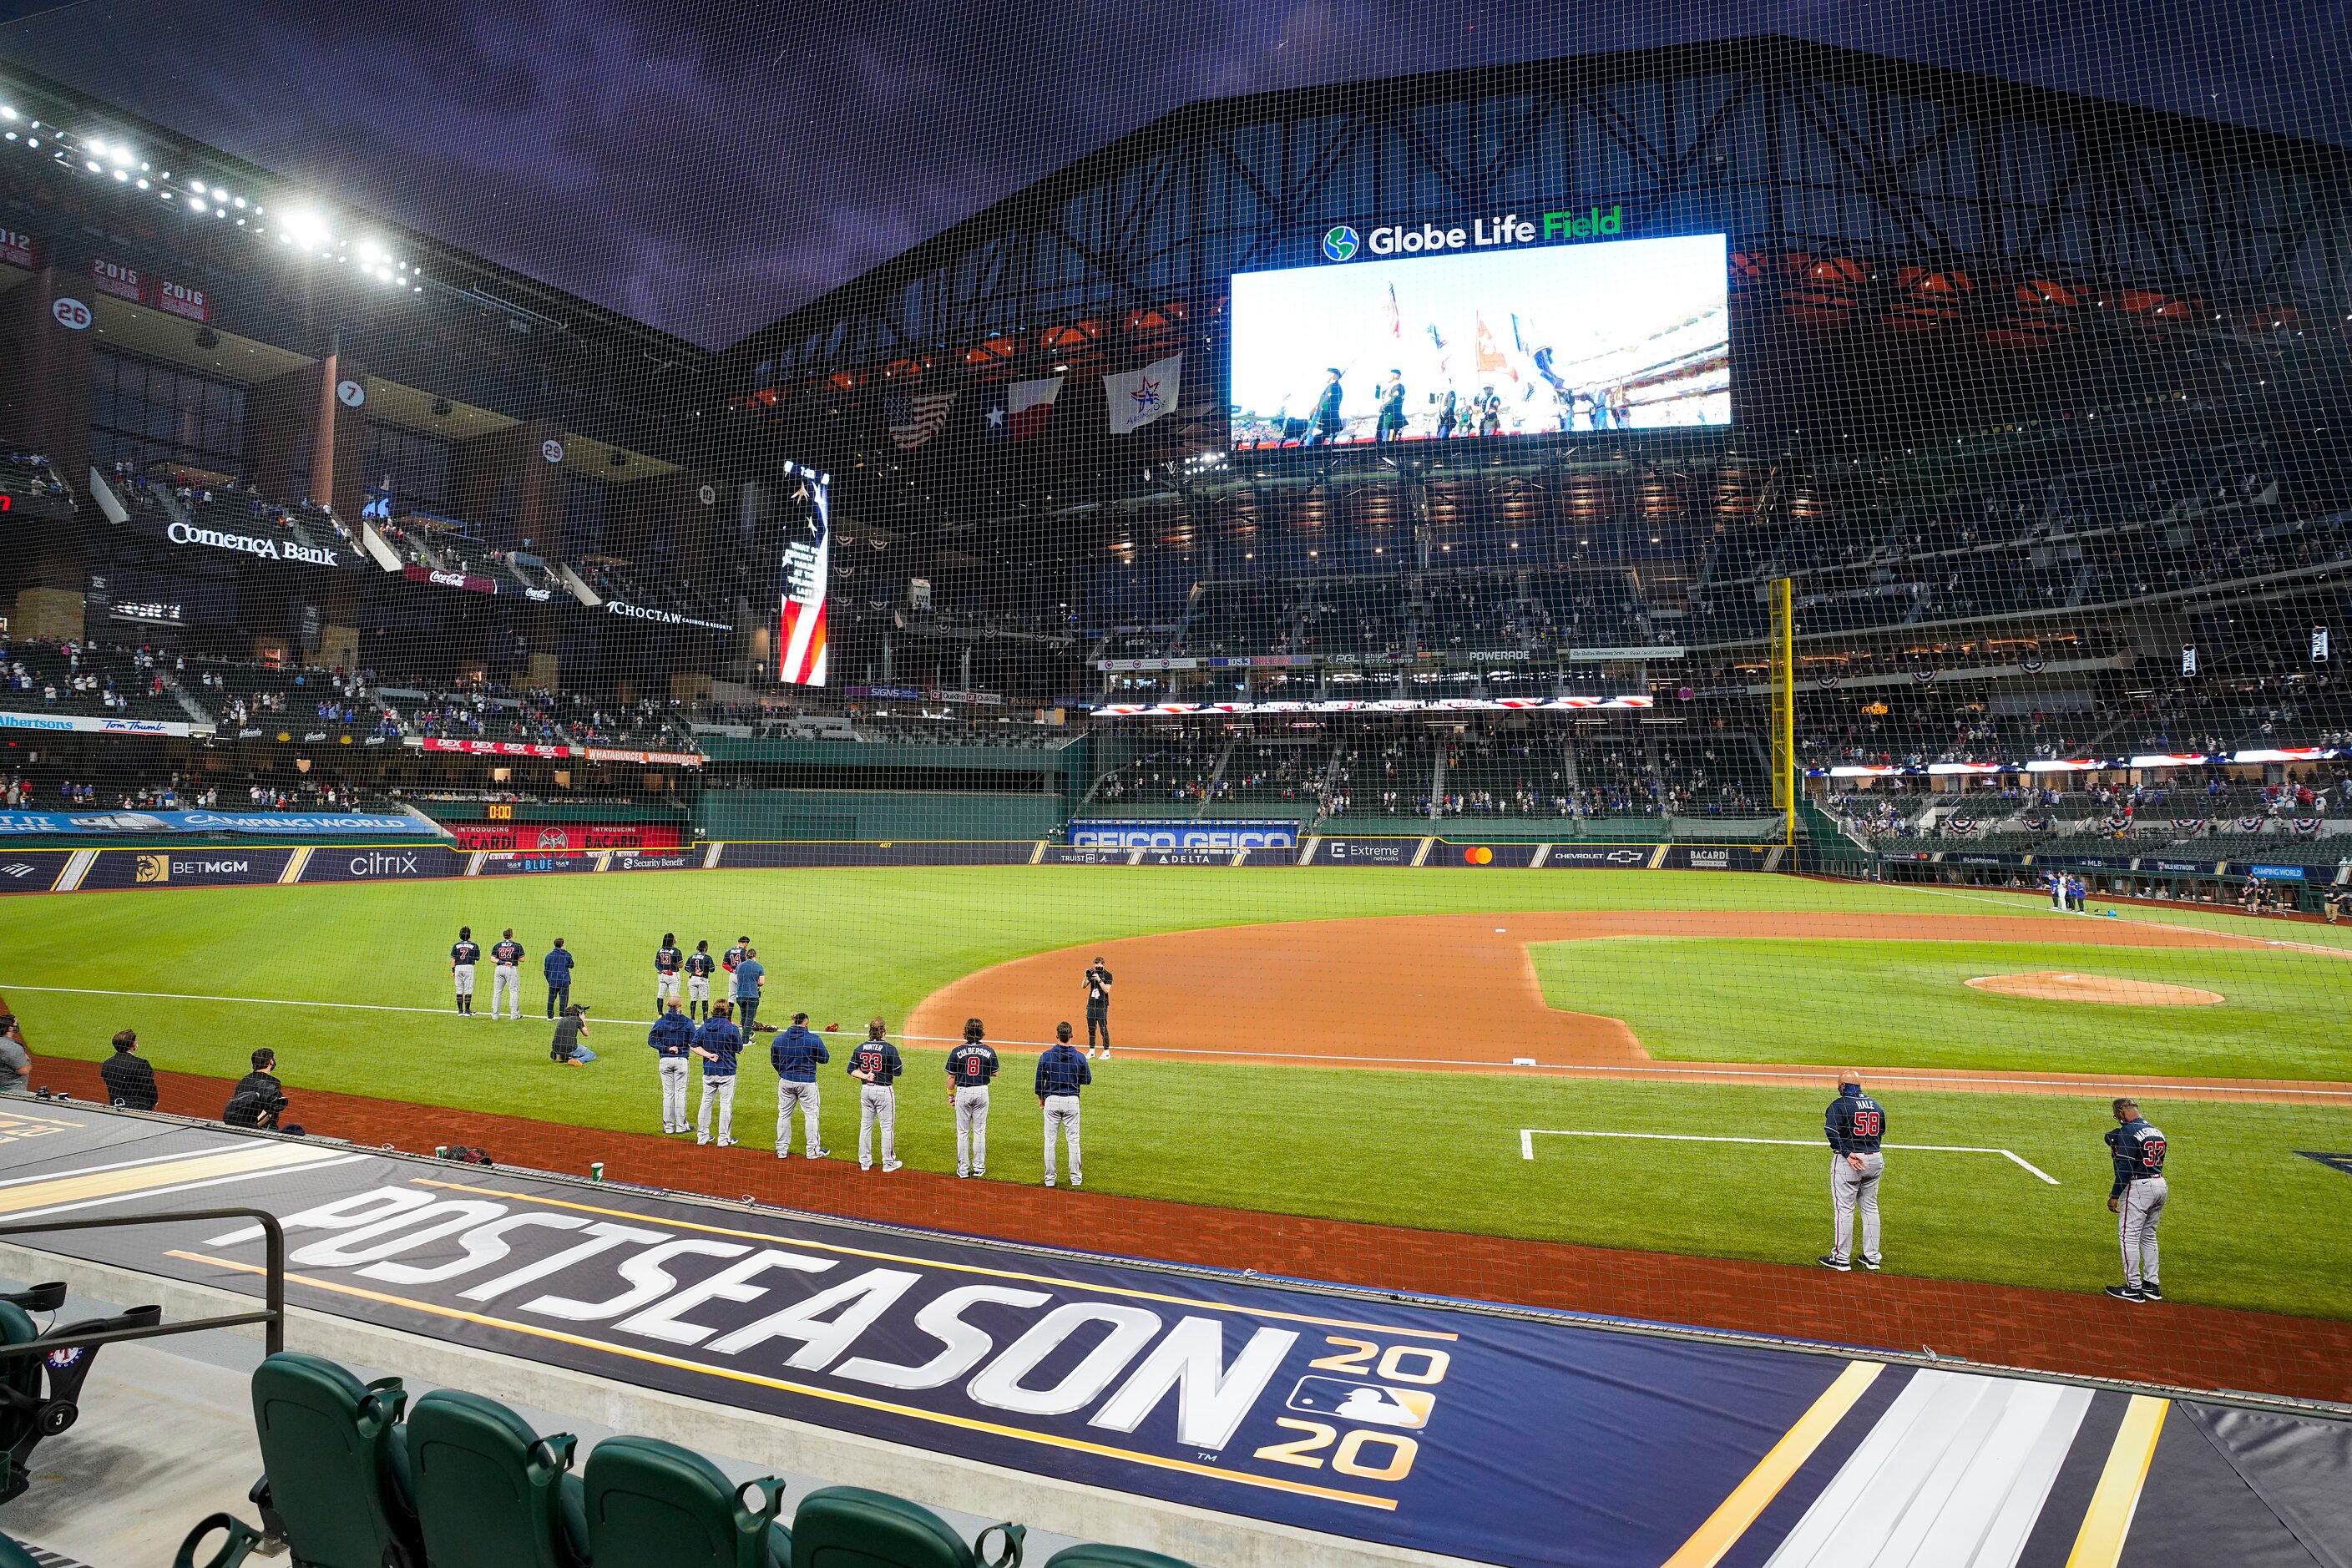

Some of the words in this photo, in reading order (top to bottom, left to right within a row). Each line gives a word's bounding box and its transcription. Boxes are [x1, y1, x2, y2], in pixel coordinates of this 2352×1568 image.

[1368, 223, 1466, 255] Globe
[1474, 215, 1535, 246] Life
[1543, 205, 1621, 240] Field
[94, 260, 137, 285] 2015
[163, 281, 204, 306] 2016
[57, 301, 88, 325] 26
[346, 387, 357, 399] 7
[544, 443, 560, 459] 29
[282, 541, 338, 566] Bank
[430, 570, 466, 587] Coca-Cola
[615, 602, 681, 625] CHOCTAW
[2313, 632, 2323, 657] TRULY
[1228, 658, 1251, 666] 105.3
[1252, 656, 1269, 665] THE
[1272, 655, 1292, 665] FAN
[1336, 655, 1359, 663] PGL
[1469, 651, 1530, 660] POWERADE
[2183, 650, 2191, 670] TRULY
[871, 688, 900, 697] SIGNS
[943, 692, 966, 701] QuikTrip
[978, 695, 999, 703] QuikTrip
[0, 716, 73, 730] Albertsons
[102, 720, 126, 730] Tom
[125, 721, 165, 731] Thumb
[437, 739, 463, 747] DEX
[589, 749, 643, 761] WHATABURGER
[648, 752, 699, 764] WHATABURGER
[489, 806, 512, 819] 0:00
[184, 815, 315, 827] CAMPING
[311, 818, 407, 827] WORLD
[458, 831, 518, 850] ACARDÍ
[585, 831, 642, 848] BACARDÍ
[1074, 832, 1176, 854] GEICO
[1183, 832, 1291, 854] GEICO
[1351, 845, 1399, 855] Extreme
[1690, 848, 1728, 860] BACARDÍ
[351, 852, 417, 875] citrix
[525, 860, 553, 869] BLUE
[634, 858, 660, 867] Security
[1171, 855, 1210, 863] DELTA
[173, 861, 248, 874] BETMGM
[2253, 867, 2282, 876] CAMPING
[460, 948, 468, 959] 7
[498, 948, 514, 959] 27
[660, 953, 671, 964] 13
[730, 953, 741, 965] 14
[695, 959, 700, 970] 1
[863, 1044, 883, 1052] MINTER
[957, 1046, 992, 1059] CULBERSON
[860, 1053, 883, 1072] 33
[967, 1056, 980, 1076] 8
[1855, 1100, 1874, 1110] HALE
[1854, 1111, 1880, 1136] 58
[2143, 1141, 2165, 1167] 37
[201, 1186, 1301, 1450] POSTSEASON
[48, 1350, 83, 1368] RANGERS
[1308, 1336, 1451, 1384] 20
[55, 1413, 63, 1426] 3
[1253, 1417, 1419, 1481] 20
[1197, 1452, 1217, 1462] TM
